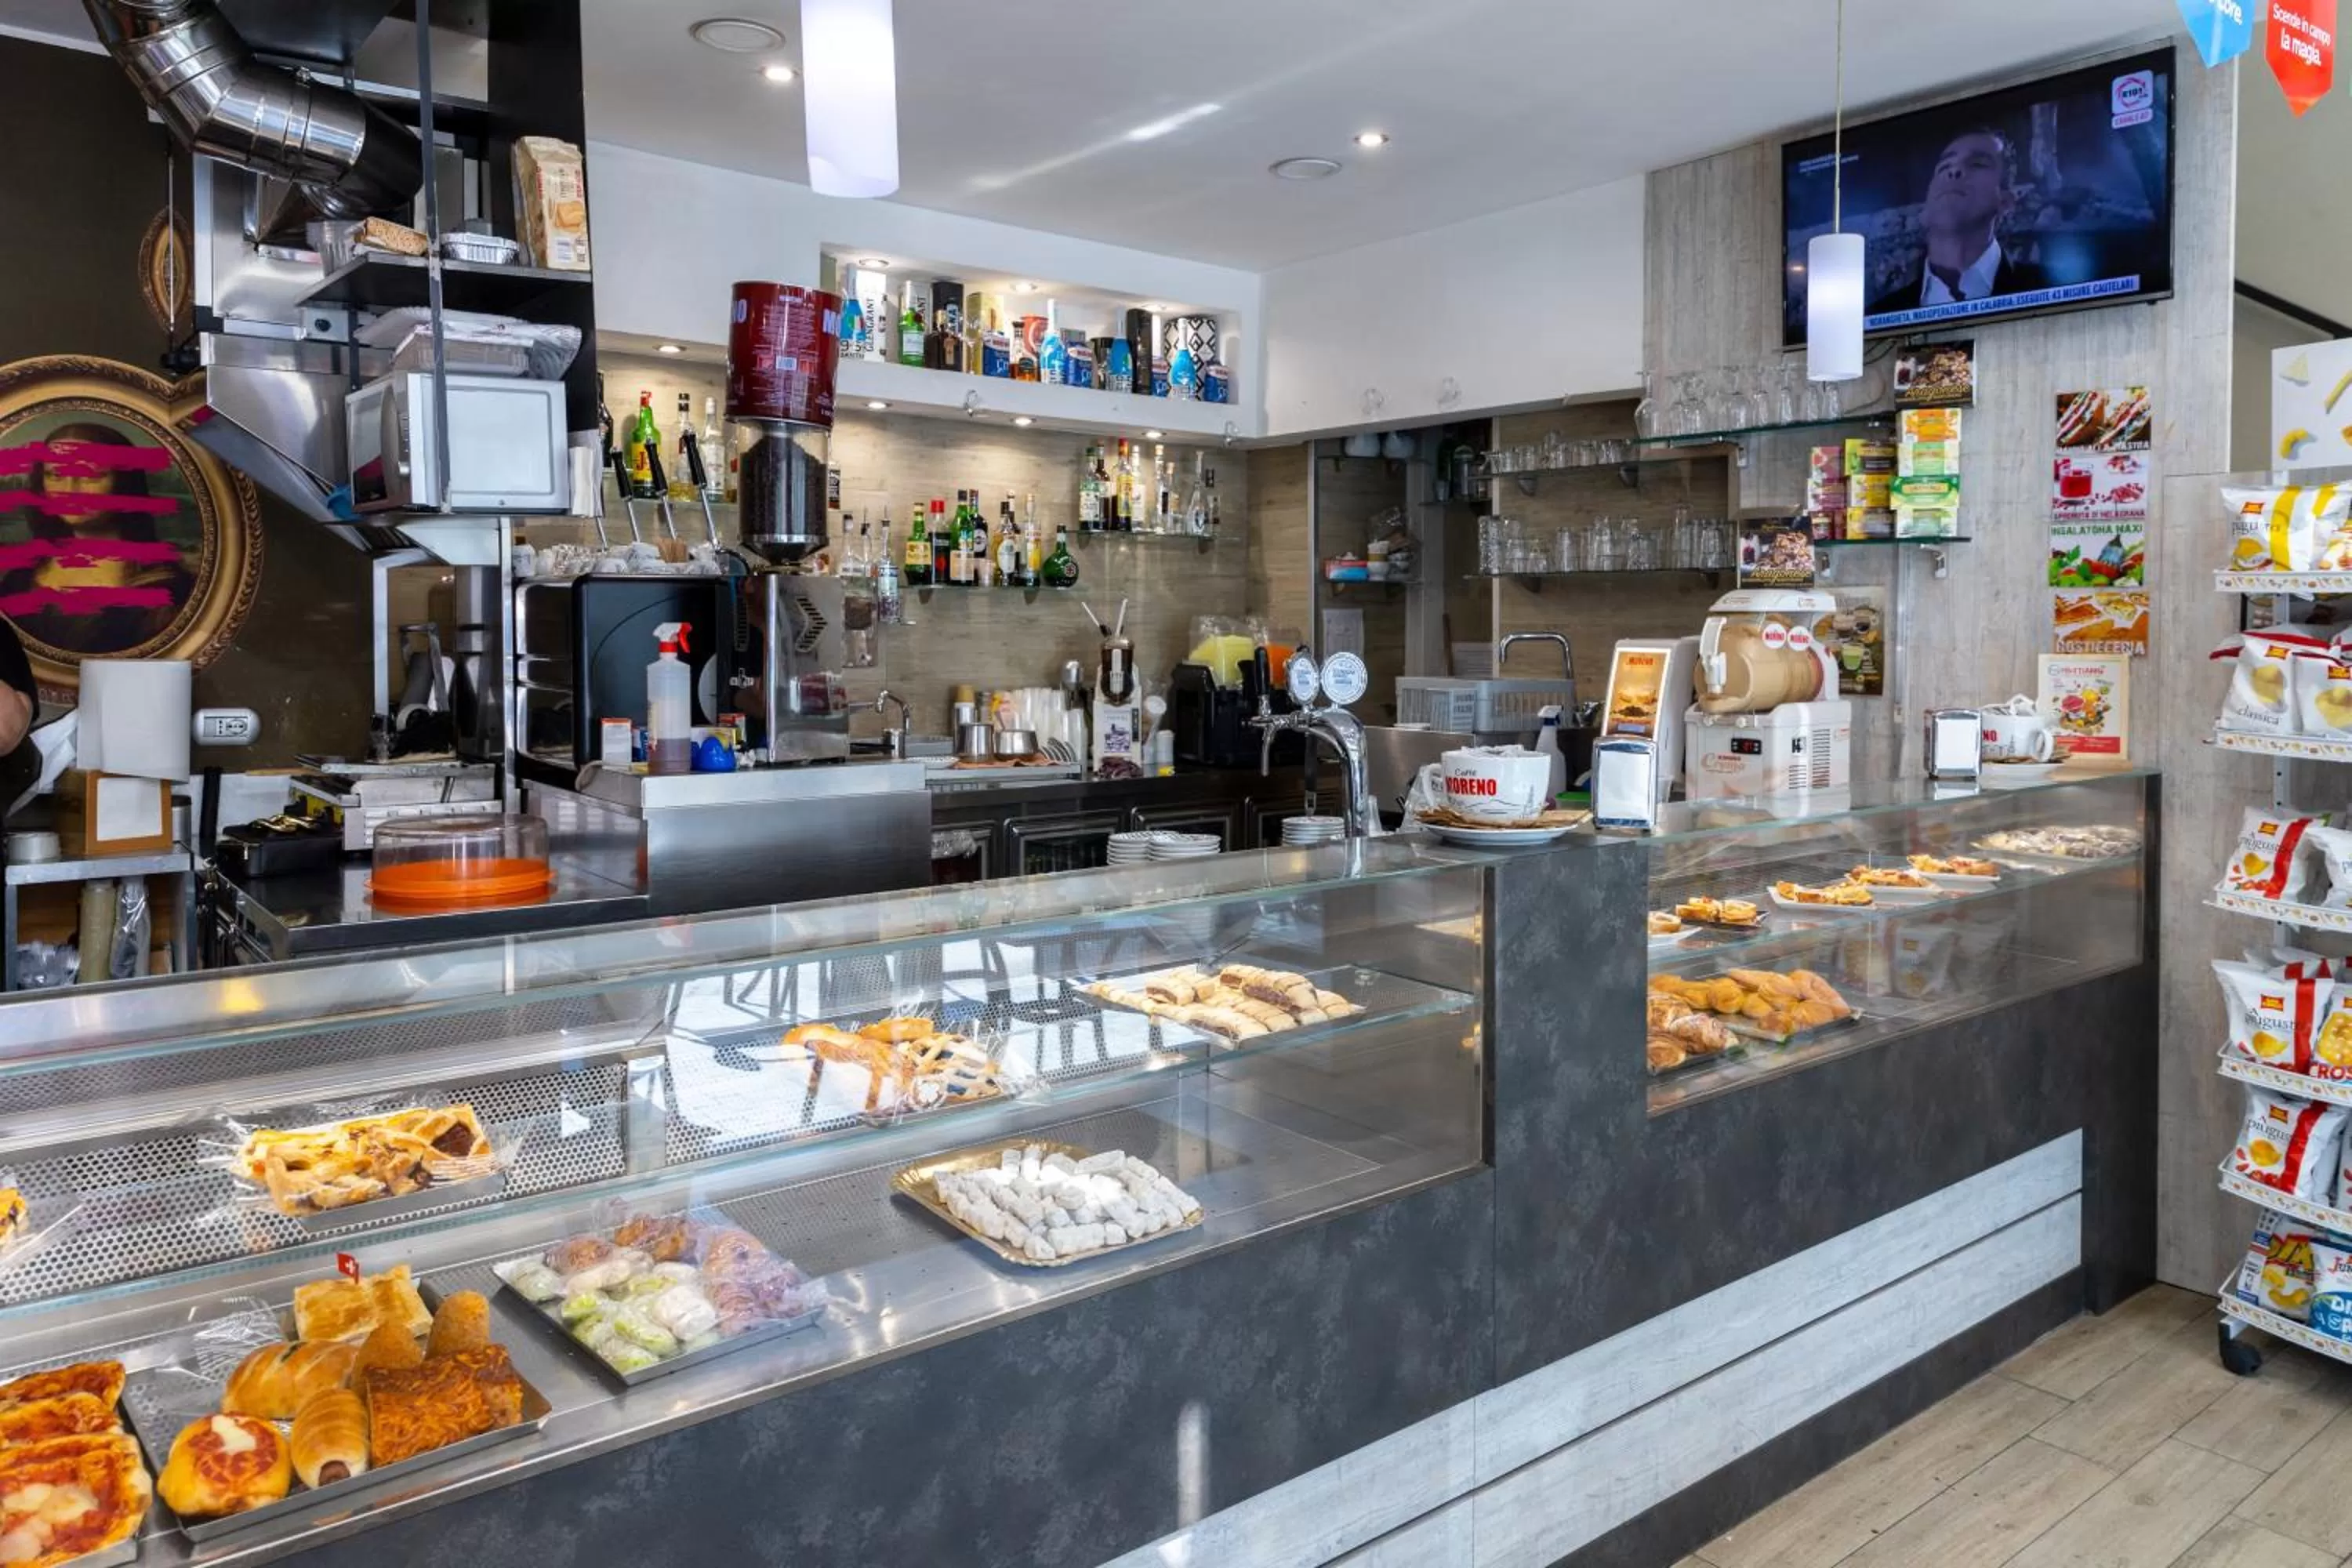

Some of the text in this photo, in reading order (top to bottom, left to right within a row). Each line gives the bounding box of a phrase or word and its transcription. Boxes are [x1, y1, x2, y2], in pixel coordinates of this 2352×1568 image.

[2274, 3, 2332, 45] Scende in campo
[2281, 28, 2321, 67] la magia.
[2093, 278, 2133, 294] CAUTELARI
[2115, 523, 2143, 535] MAXI
[1446, 776, 1497, 796] MORENO
